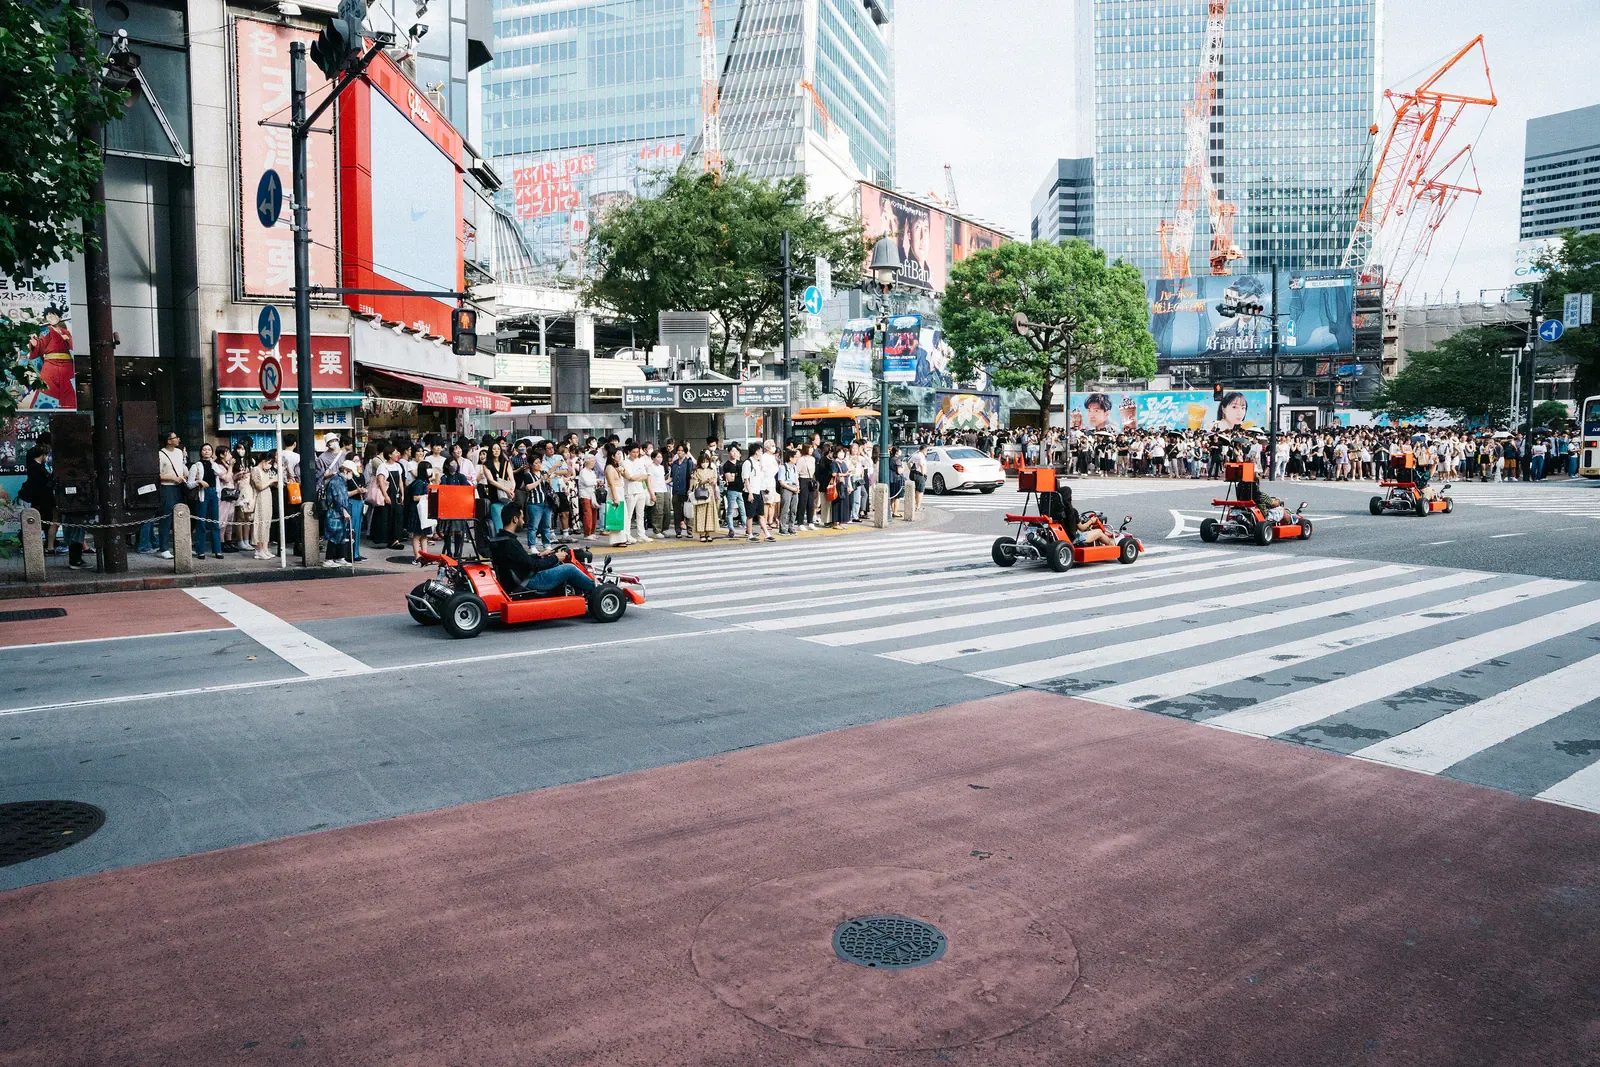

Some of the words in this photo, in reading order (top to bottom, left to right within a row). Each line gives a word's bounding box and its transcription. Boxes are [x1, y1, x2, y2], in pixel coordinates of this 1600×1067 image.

[892, 258, 933, 284] oftBan
[225, 348, 343, 375] 天栗
[698, 388, 730, 398] しぶちか
